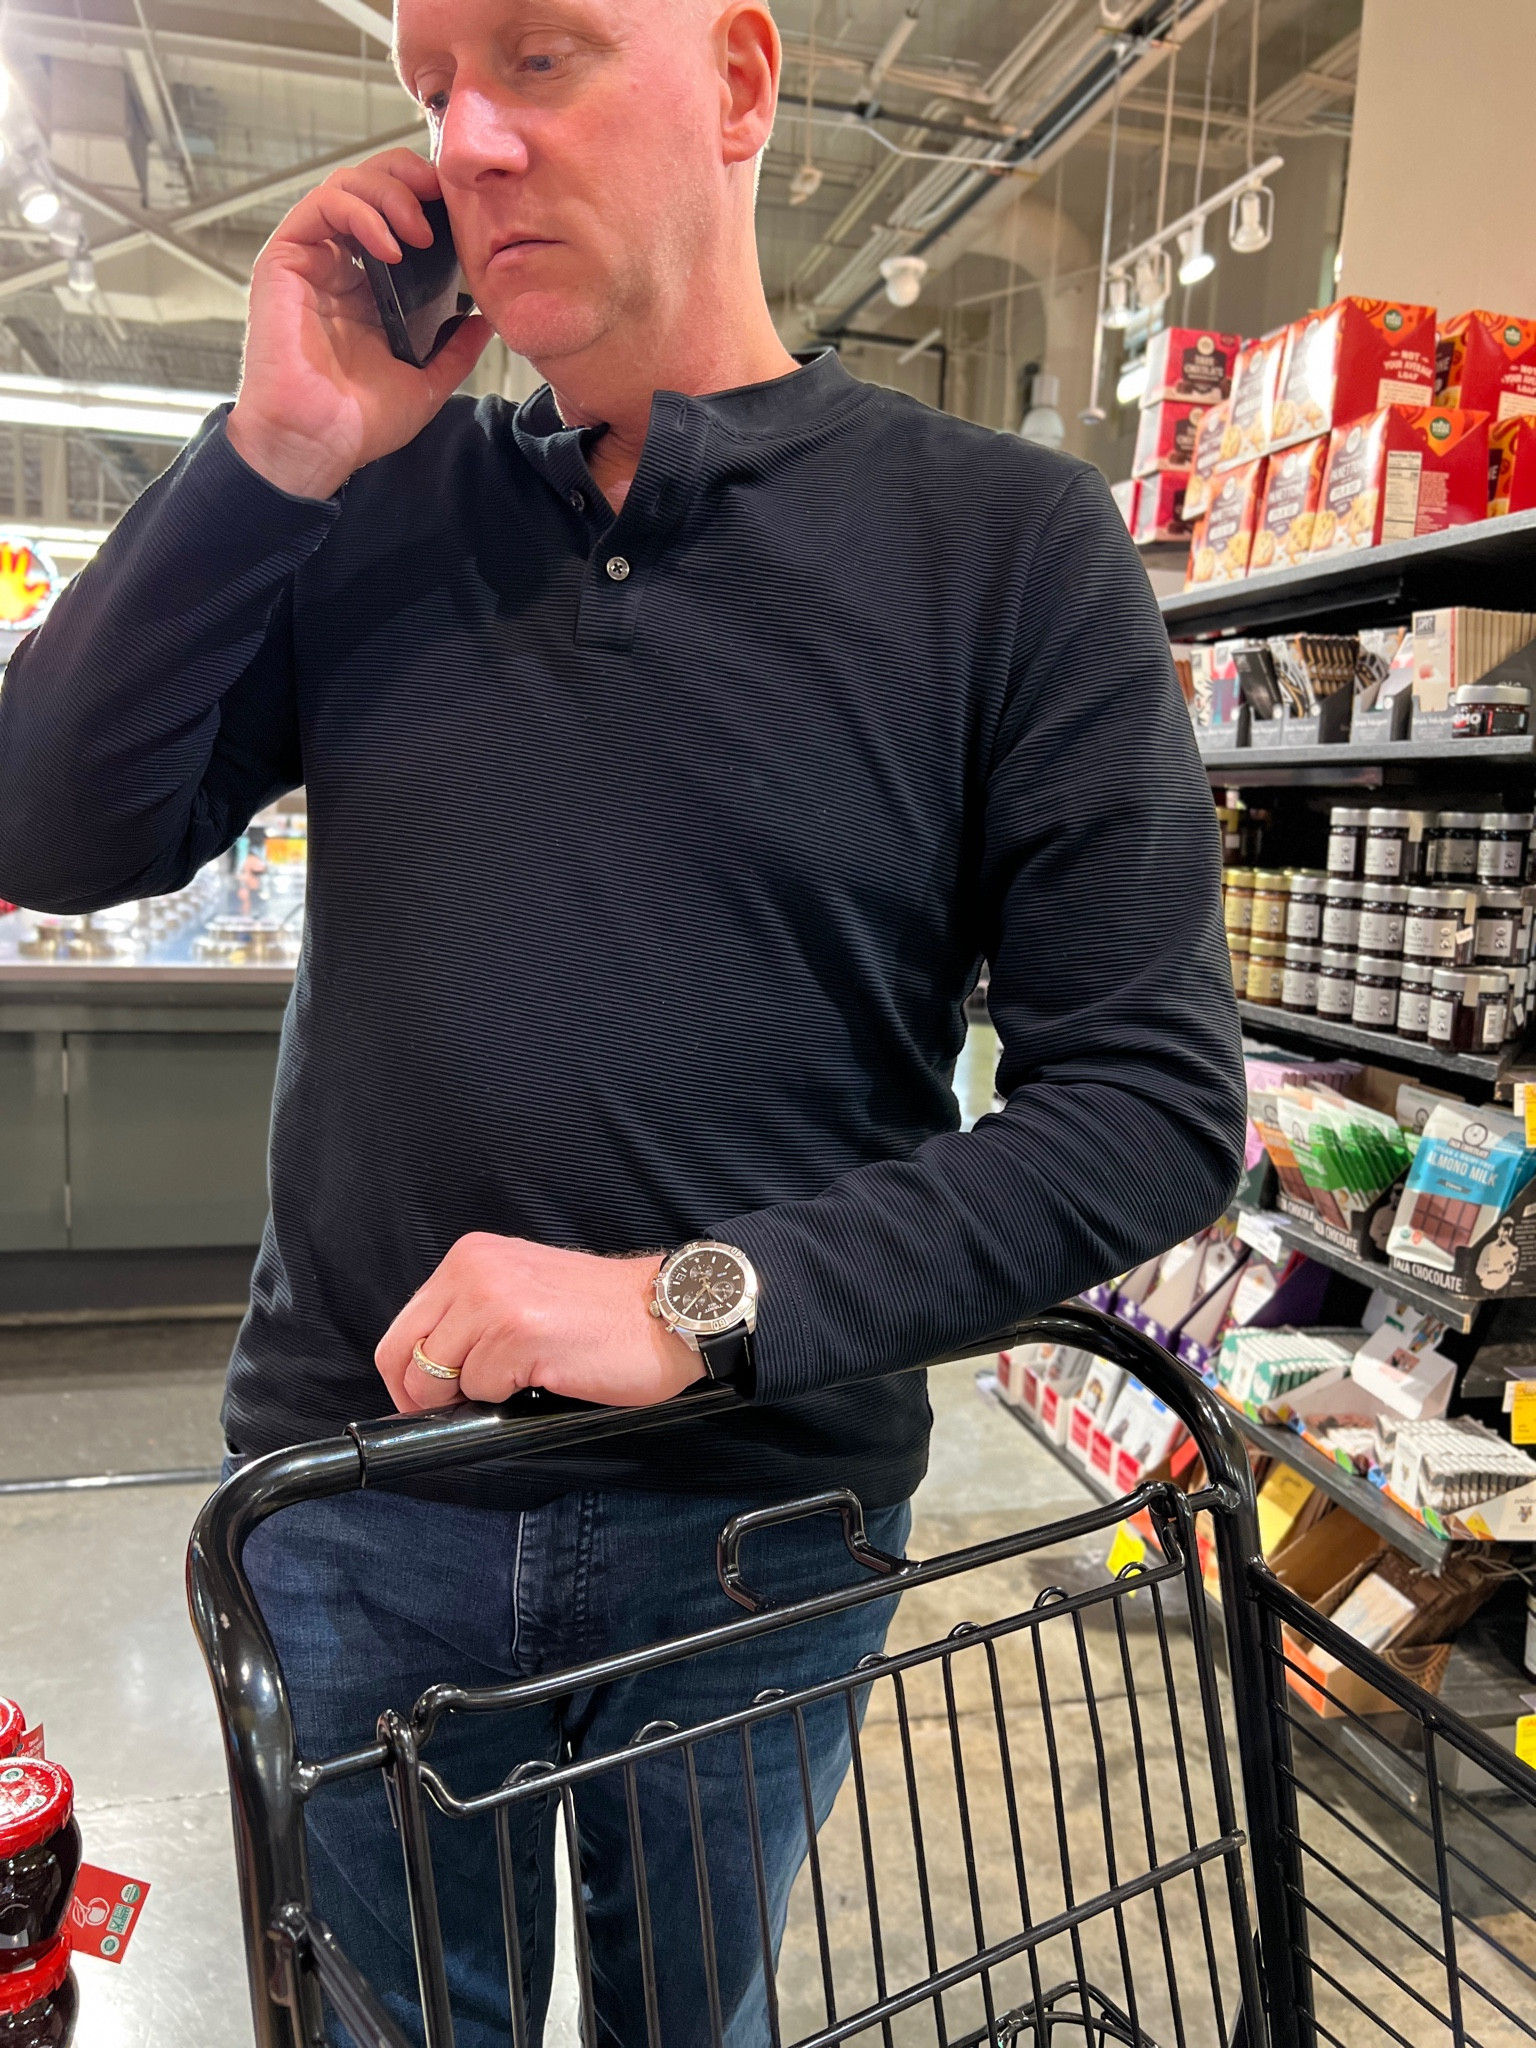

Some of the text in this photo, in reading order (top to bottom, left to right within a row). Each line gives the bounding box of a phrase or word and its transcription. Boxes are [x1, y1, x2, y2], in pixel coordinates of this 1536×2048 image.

[1401, 350, 1420, 360] NOT
[1383, 360, 1403, 371] YOUR
[1404, 360, 1433, 379] AVERAGE
[1398, 371, 1419, 381] LOAF
[1427, 1150, 1499, 1187] ALMOND MILK
[686, 1242, 699, 1251] 30
[730, 1247, 743, 1258] 40
[1412, 1264, 1463, 1293] CHOCOLATE
[712, 1319, 726, 1330] 60
